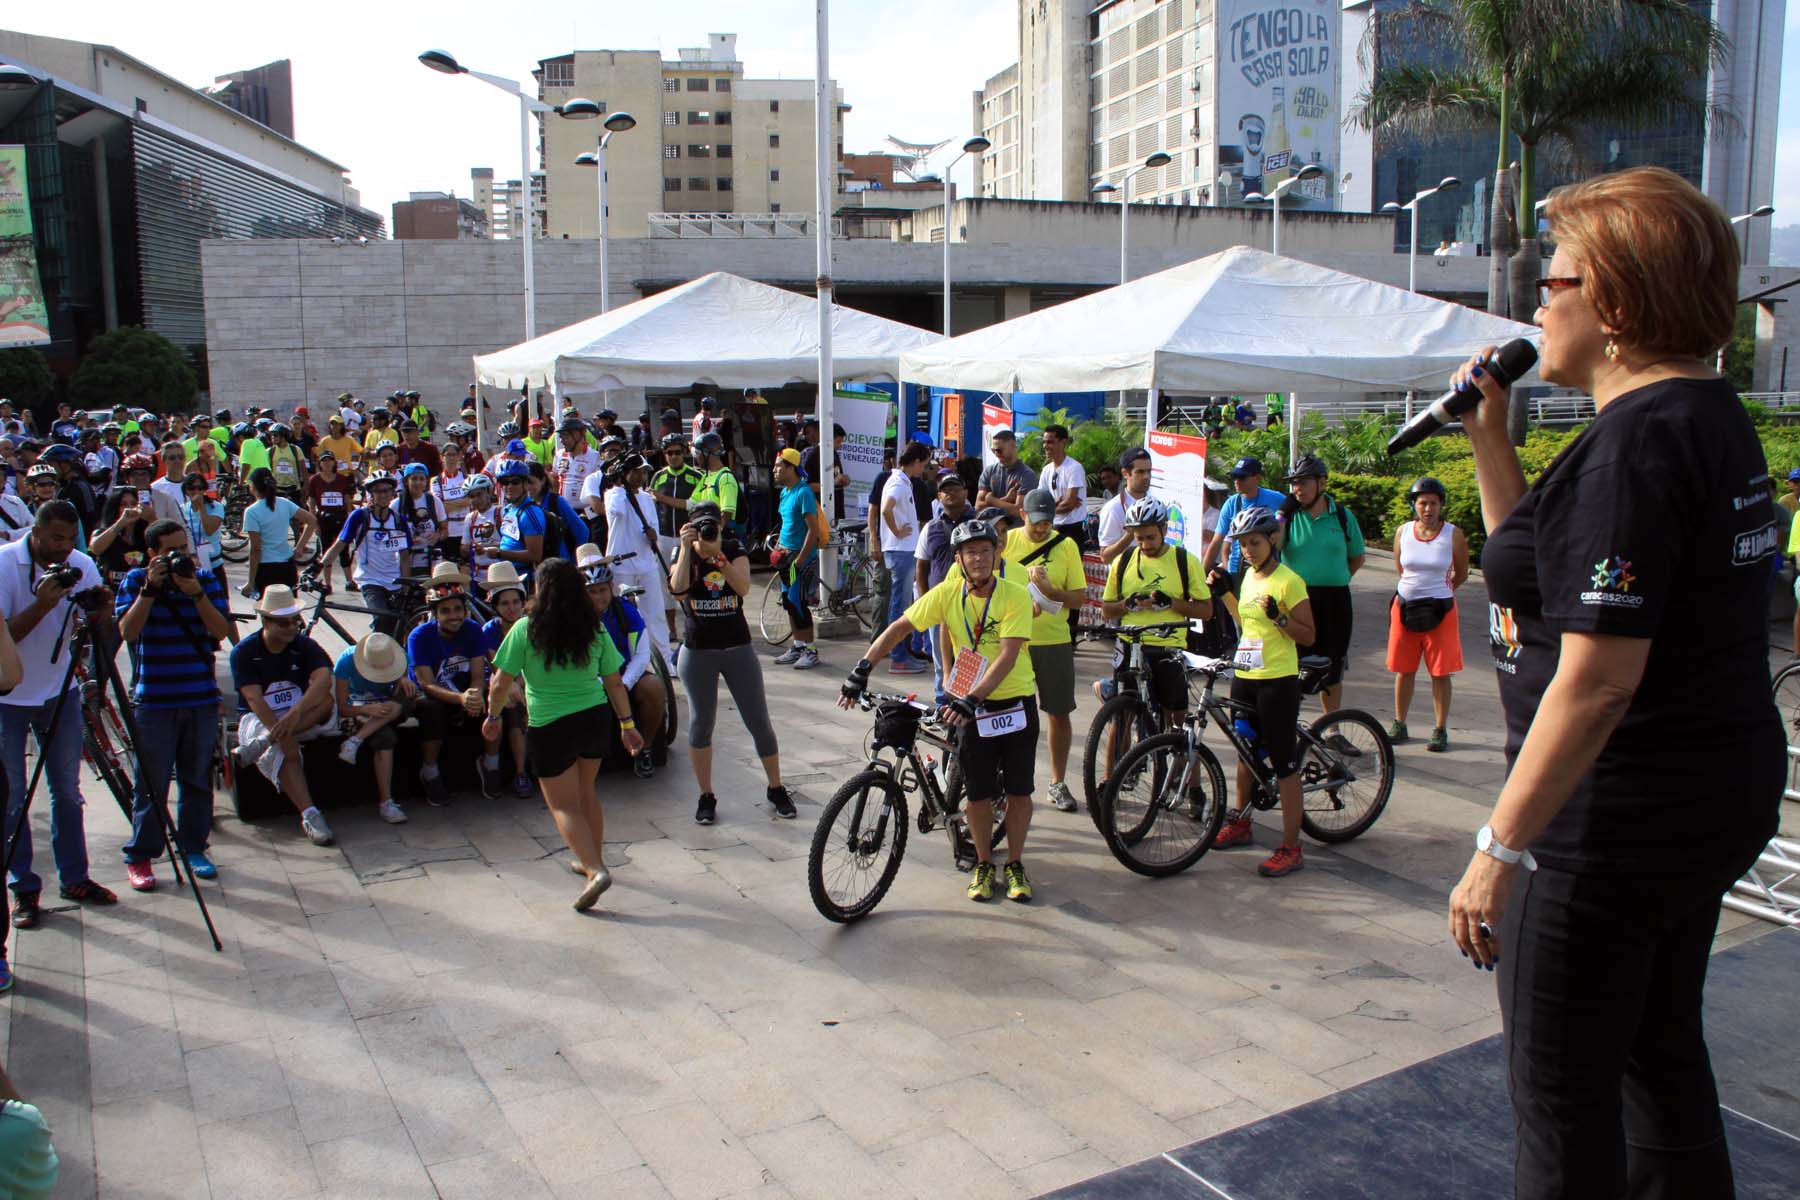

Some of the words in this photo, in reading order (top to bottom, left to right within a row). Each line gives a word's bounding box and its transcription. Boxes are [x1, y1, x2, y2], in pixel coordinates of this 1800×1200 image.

[1230, 8, 1303, 63] TENGO
[1307, 14, 1328, 41] LA
[1241, 51, 1283, 88] CASA
[1288, 46, 1329, 77] SOLA
[1316, 92, 1329, 108] LO
[1268, 158, 1288, 169] ICE
[274, 691, 293, 704] 009
[991, 715, 1014, 730] 002
